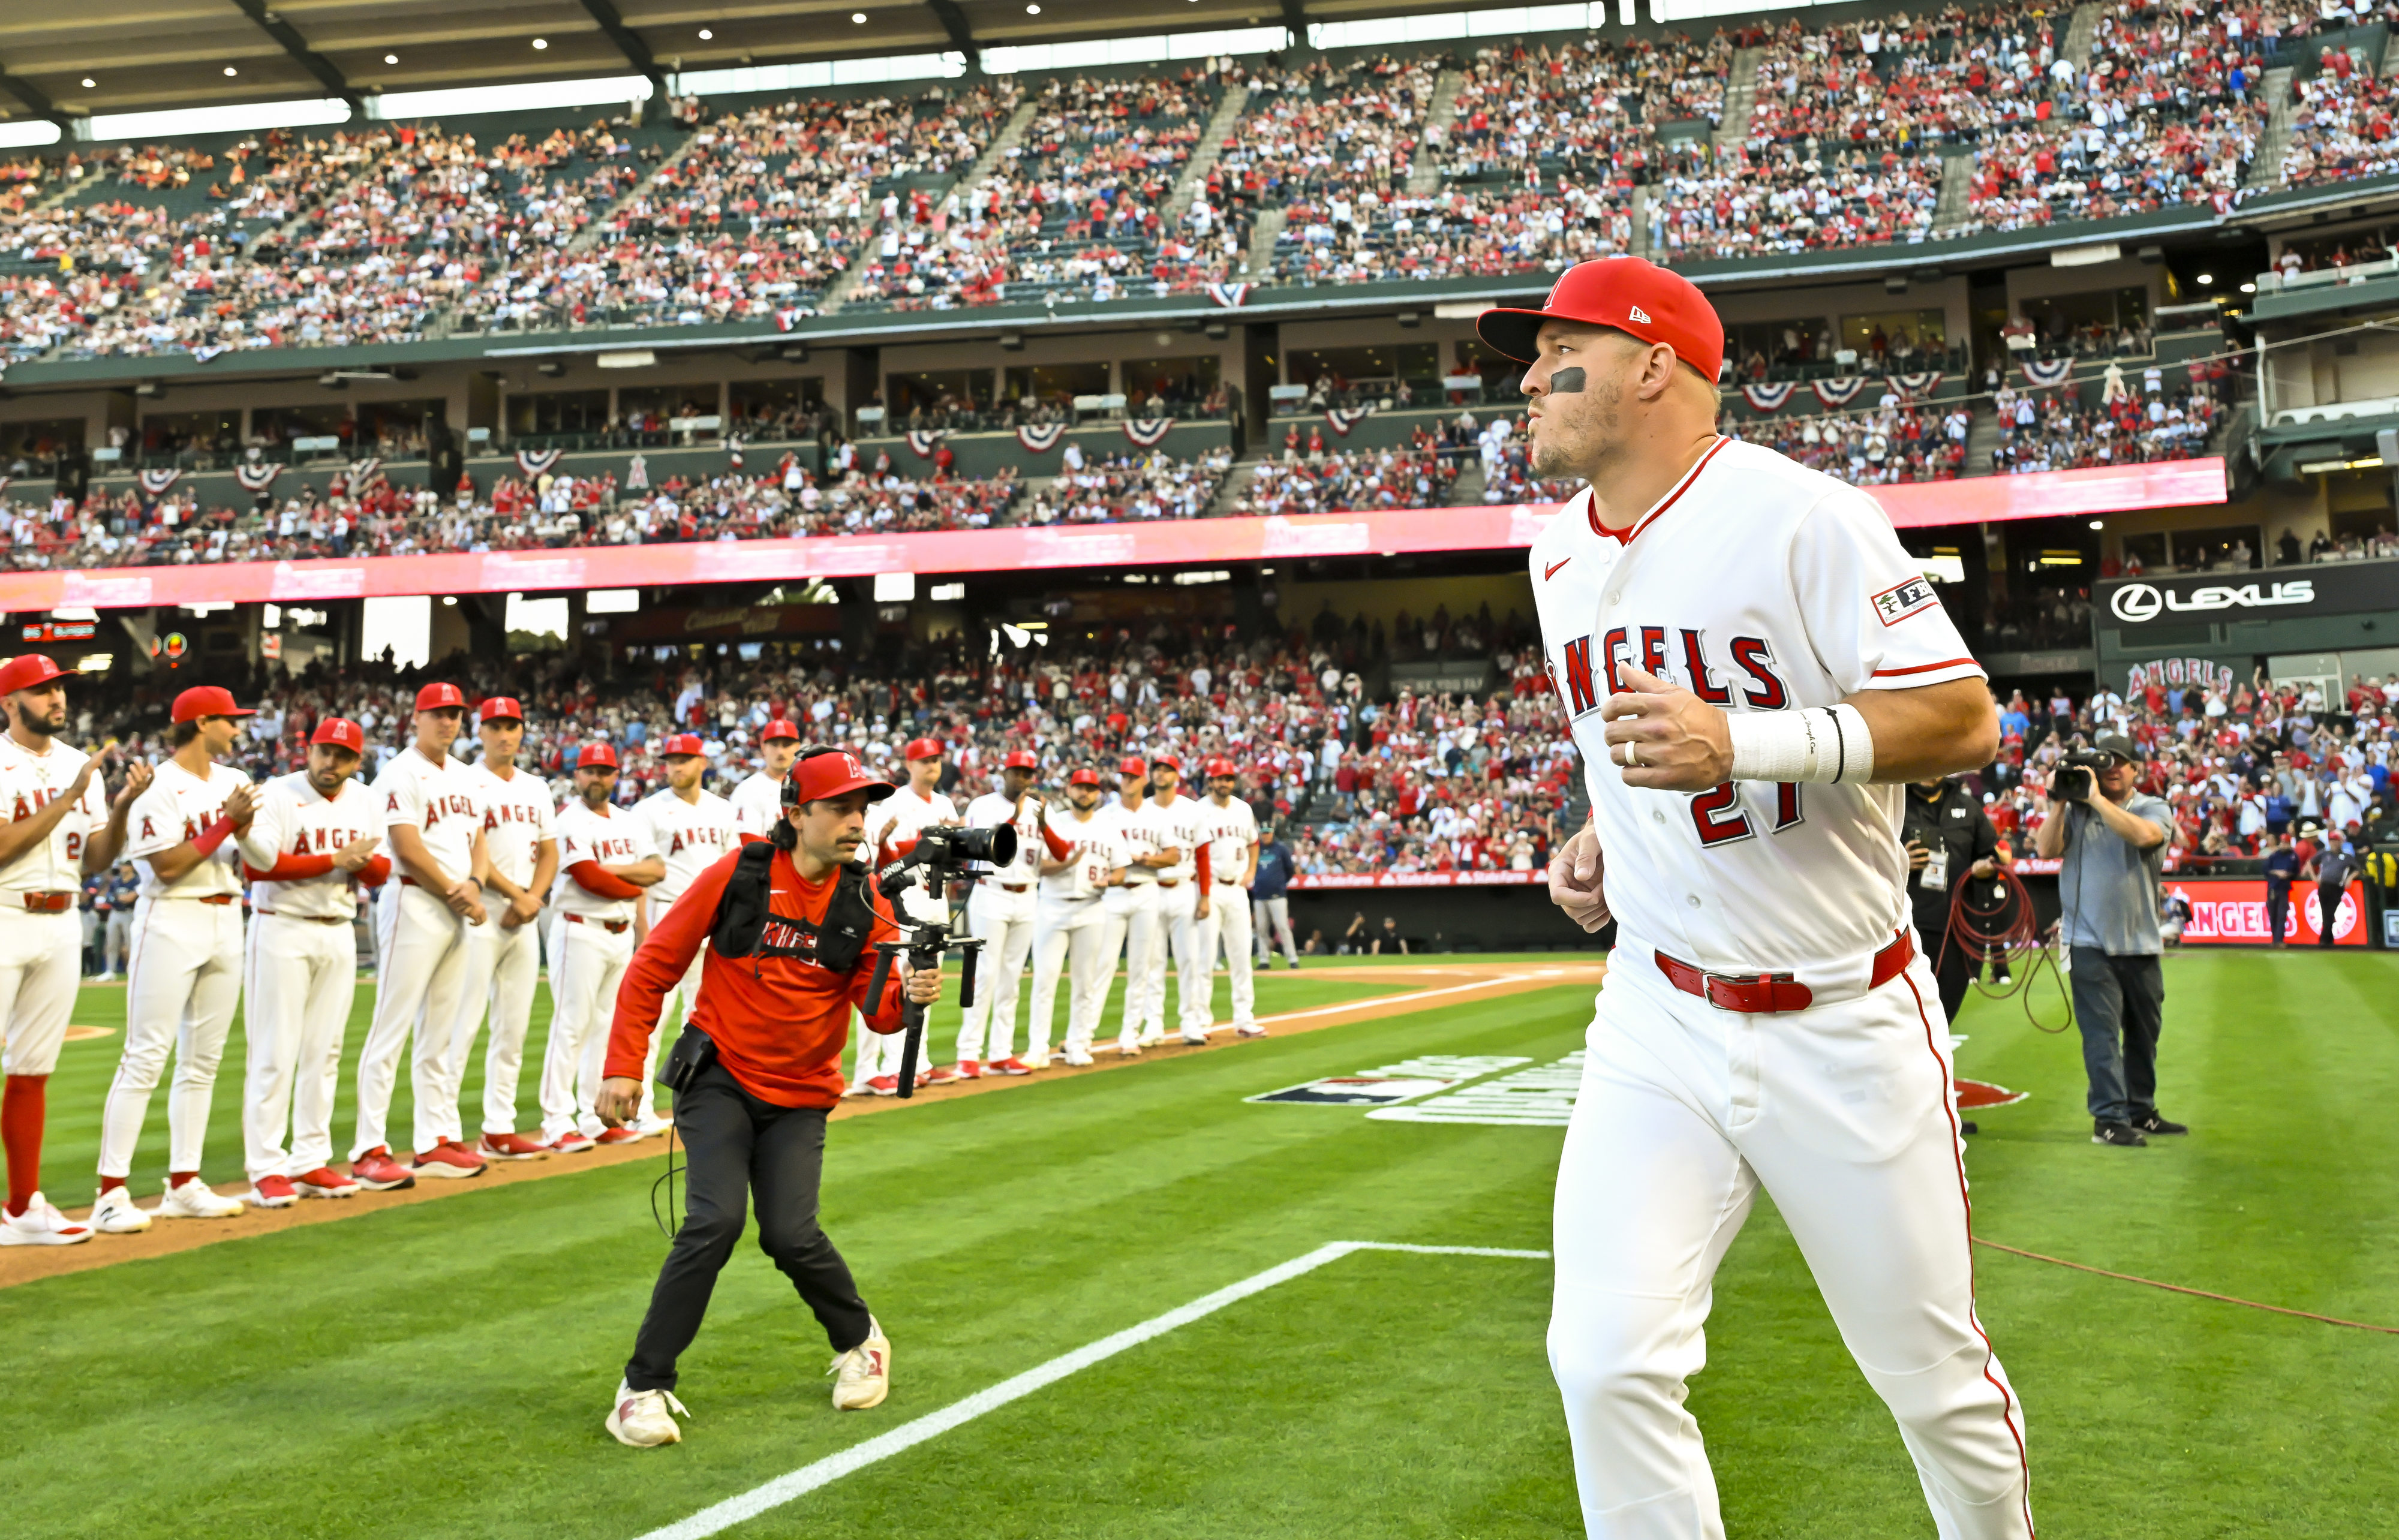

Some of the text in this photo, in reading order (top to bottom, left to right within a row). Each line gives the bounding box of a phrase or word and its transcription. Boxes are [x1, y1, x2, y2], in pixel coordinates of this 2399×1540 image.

[1902, 580, 1932, 603] FB
[2165, 580, 2315, 612] LEXUS
[2126, 657, 2233, 703] ANGELS
[843, 752, 867, 778] A
[141, 815, 156, 840] A
[2175, 888, 2298, 937] NGELS
